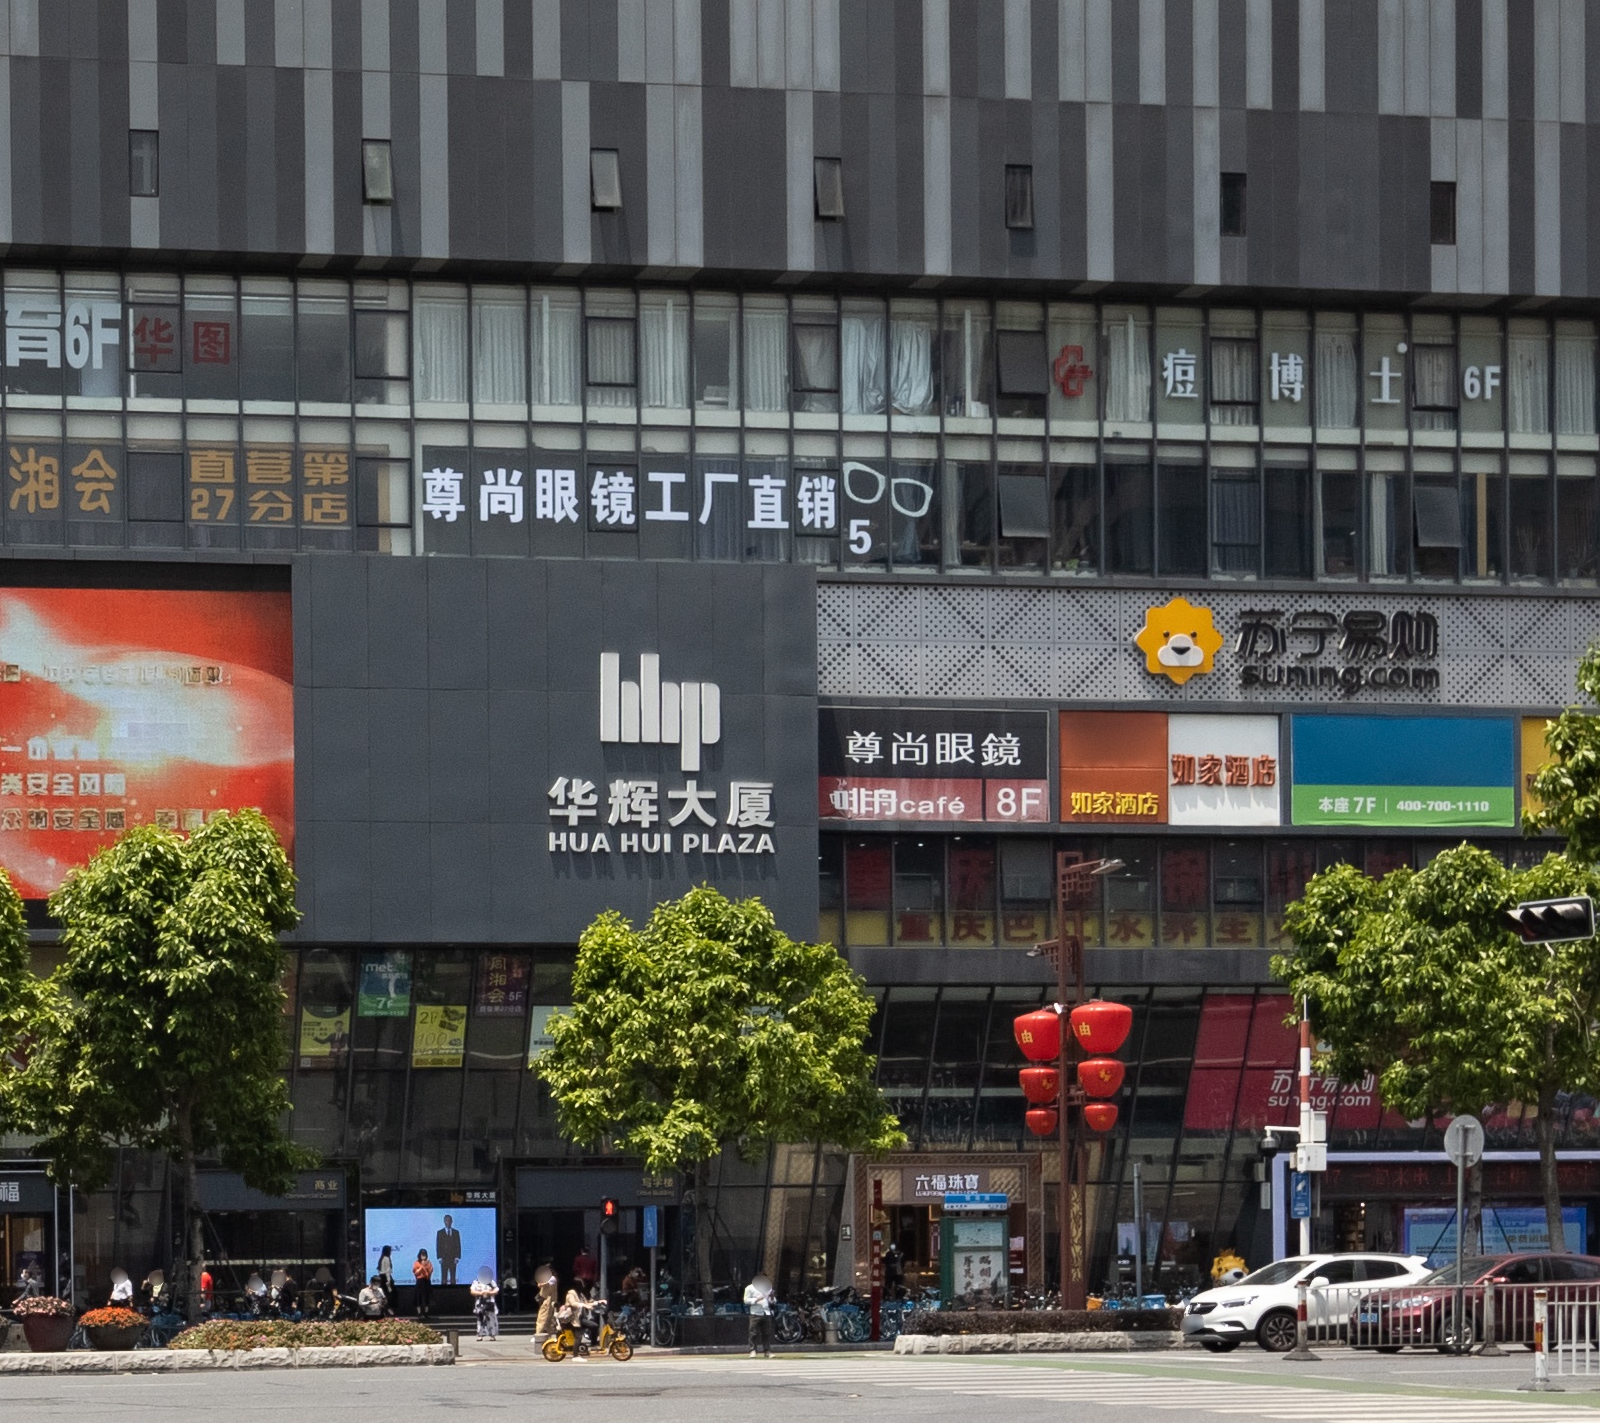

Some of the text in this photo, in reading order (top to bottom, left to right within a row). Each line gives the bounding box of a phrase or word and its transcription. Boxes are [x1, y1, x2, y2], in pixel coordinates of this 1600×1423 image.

[133, 316, 231, 365] 华图
[1163, 349, 1502, 404] 痘博士 6F
[422, 466, 837, 531] 尊尚眼镜工厂直销
[848, 519, 872, 554] 5
[1236, 608, 1439, 659] 苏宁易购
[1238, 663, 1441, 694] suning.com
[845, 730, 1022, 766] 尊尚眼鏡
[1171, 754, 1277, 788] 如家酒店
[548, 776, 776, 829] 华辉大厦
[997, 788, 1042, 817] 8F
[1070, 791, 1159, 816] 如家酒店
[1318, 797, 1489, 814] 本座 7F 400-700-1110
[548, 831, 775, 854] HUA HUI PLAZA
[508, 991, 523, 1001] 5F
[314, 1179, 338, 1190] 商业
[915, 1174, 979, 1191] 六福珠寶
